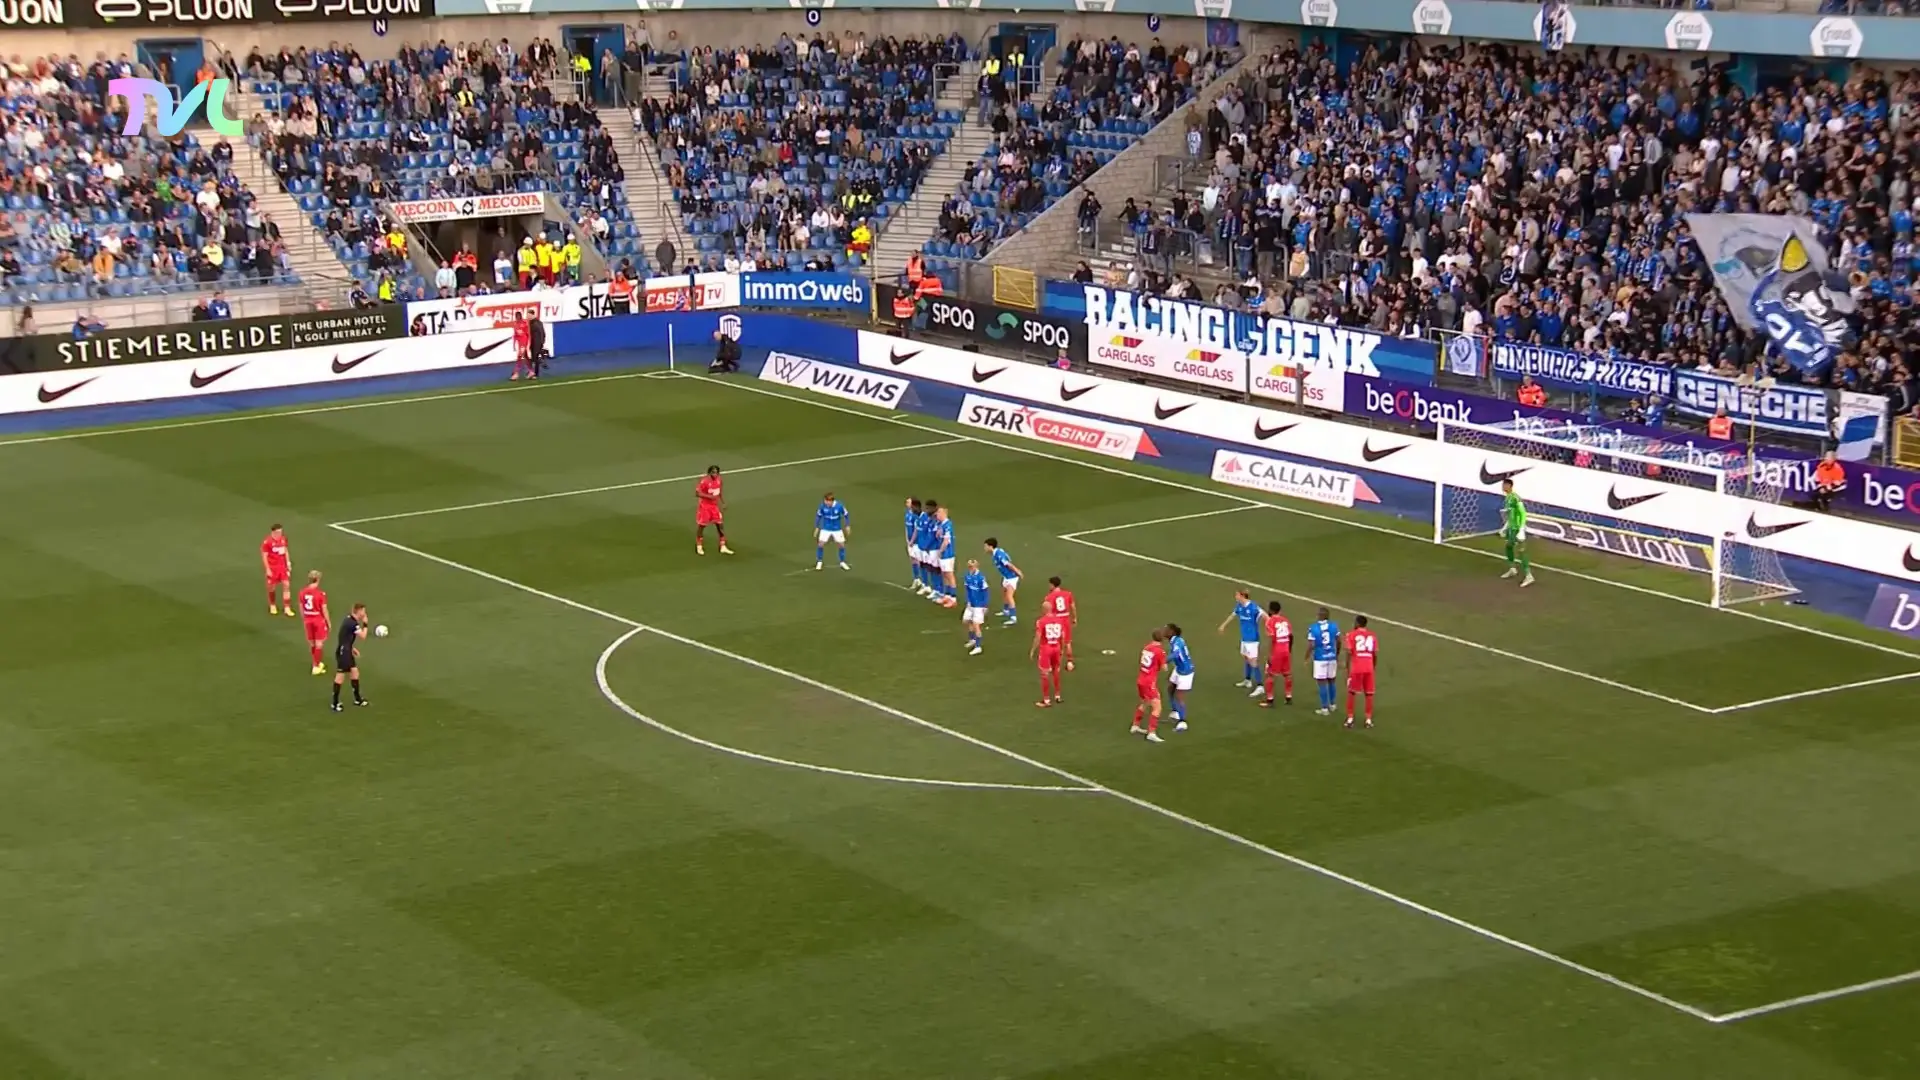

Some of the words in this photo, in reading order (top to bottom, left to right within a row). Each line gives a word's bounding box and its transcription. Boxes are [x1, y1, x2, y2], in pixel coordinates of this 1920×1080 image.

[477, 194, 541, 209] MECONA
[707, 287, 722, 300] TV
[543, 305, 560, 317] TV
[932, 302, 975, 331] SPOQ
[293, 323, 313, 332] THE
[316, 318, 351, 329] URBAN
[354, 315, 387, 325] HOTEL
[1083, 285, 1226, 346] RACING
[1265, 317, 1382, 377] GENK
[57, 324, 283, 364] STIEMERHEIDE
[305, 331, 329, 342] GOLF
[333, 327, 372, 339] RETREAT
[1023, 320, 1070, 349] SPOQ
[1098, 346, 1155, 368] CARGLASS
[1173, 360, 1234, 383] CARGLASS
[812, 367, 900, 402] WILMS
[968, 405, 1025, 433] STAR
[1037, 422, 1099, 445] CASINO
[1105, 436, 1124, 449] TV
[1249, 461, 1351, 493] CALLANT
[304, 595, 314, 610] 3
[1055, 596, 1066, 611] 8
[1321, 631, 1330, 645] 3
[1355, 635, 1374, 652] 24
